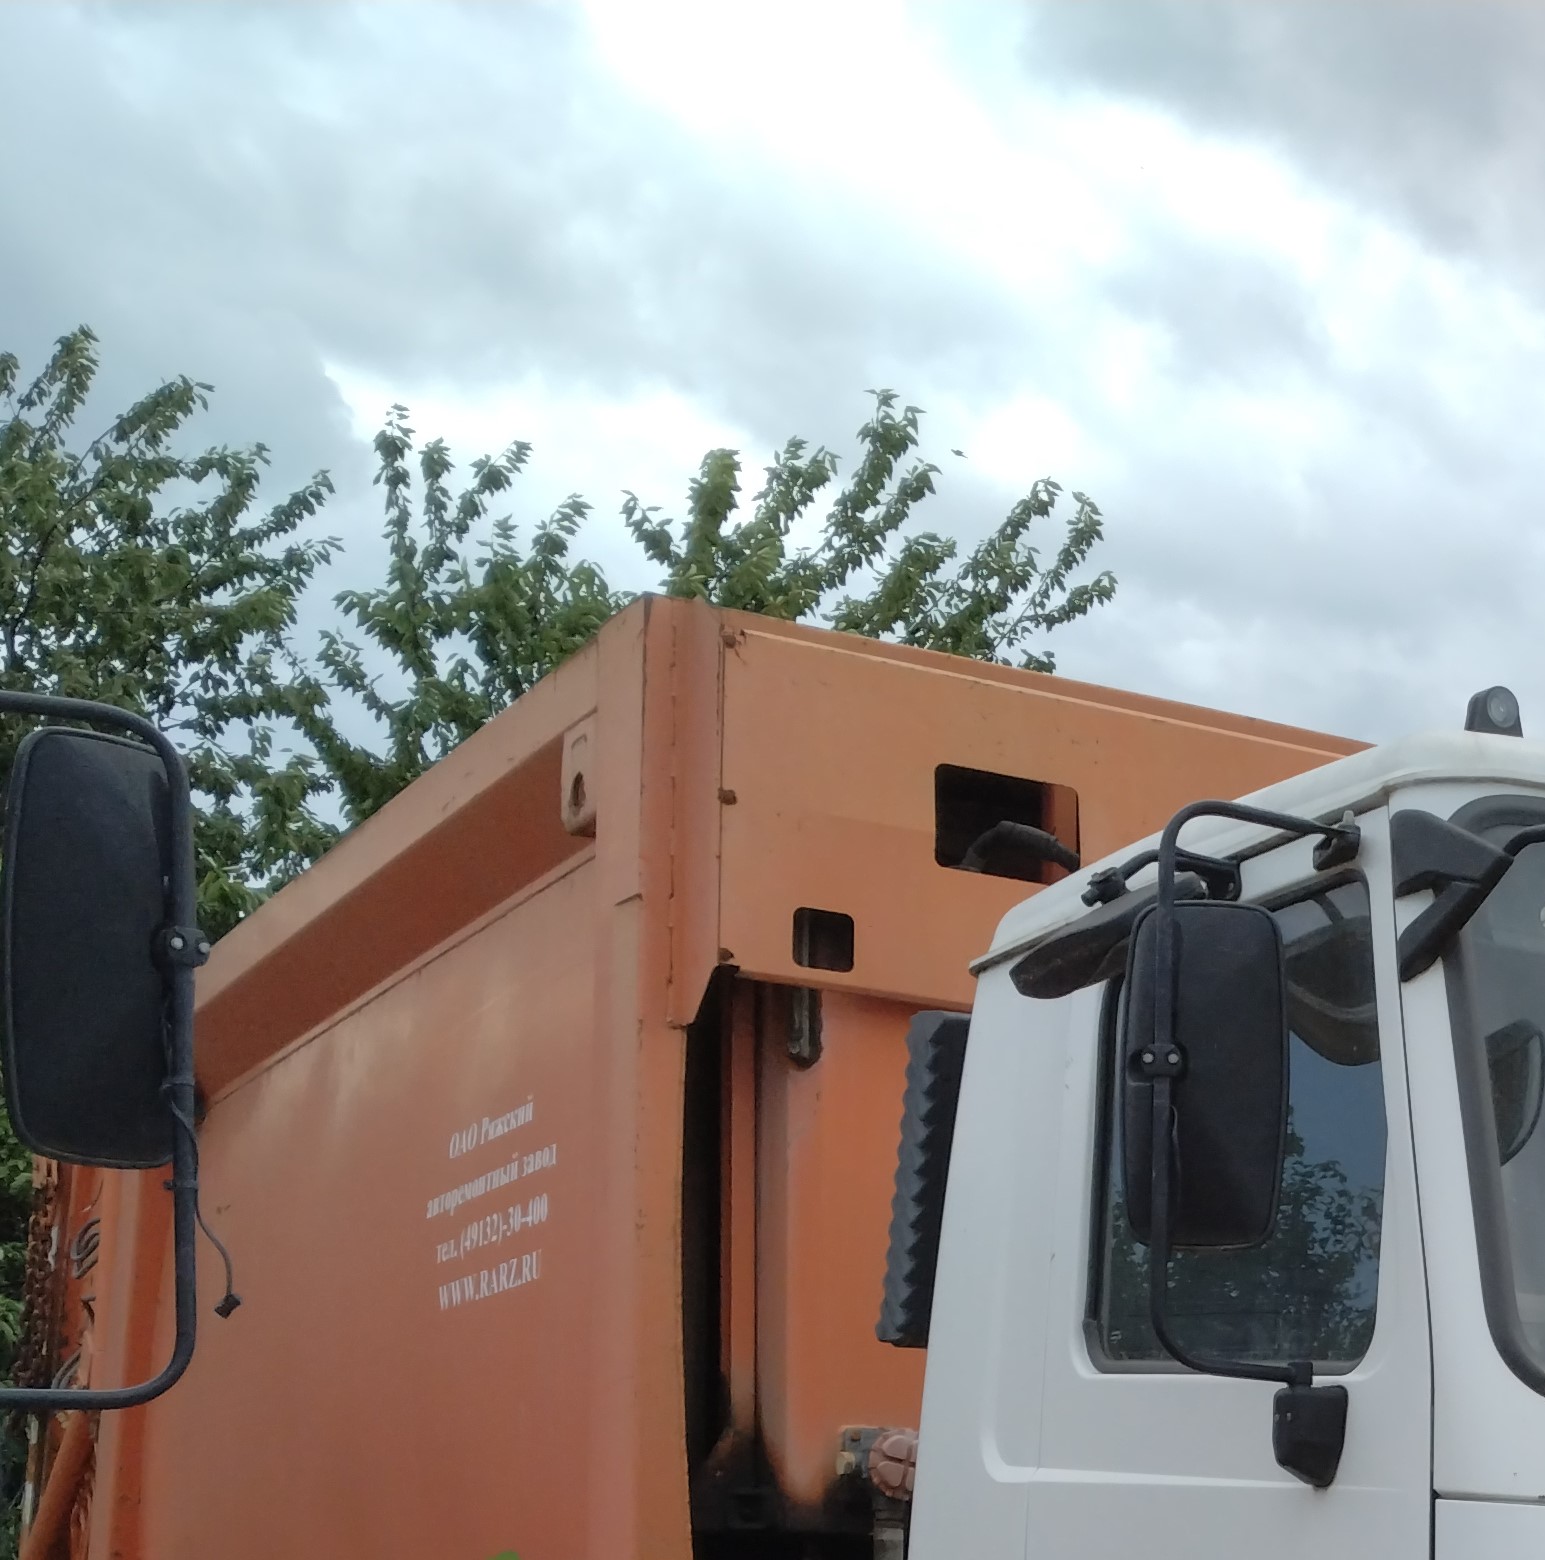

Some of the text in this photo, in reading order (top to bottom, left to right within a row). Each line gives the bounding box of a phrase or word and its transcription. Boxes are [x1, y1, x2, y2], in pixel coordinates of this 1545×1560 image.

[449, 1122, 478, 1158] ОАО
[522, 1143, 557, 1177] завод
[438, 1249, 542, 1310] WWW.RARZ.RU
